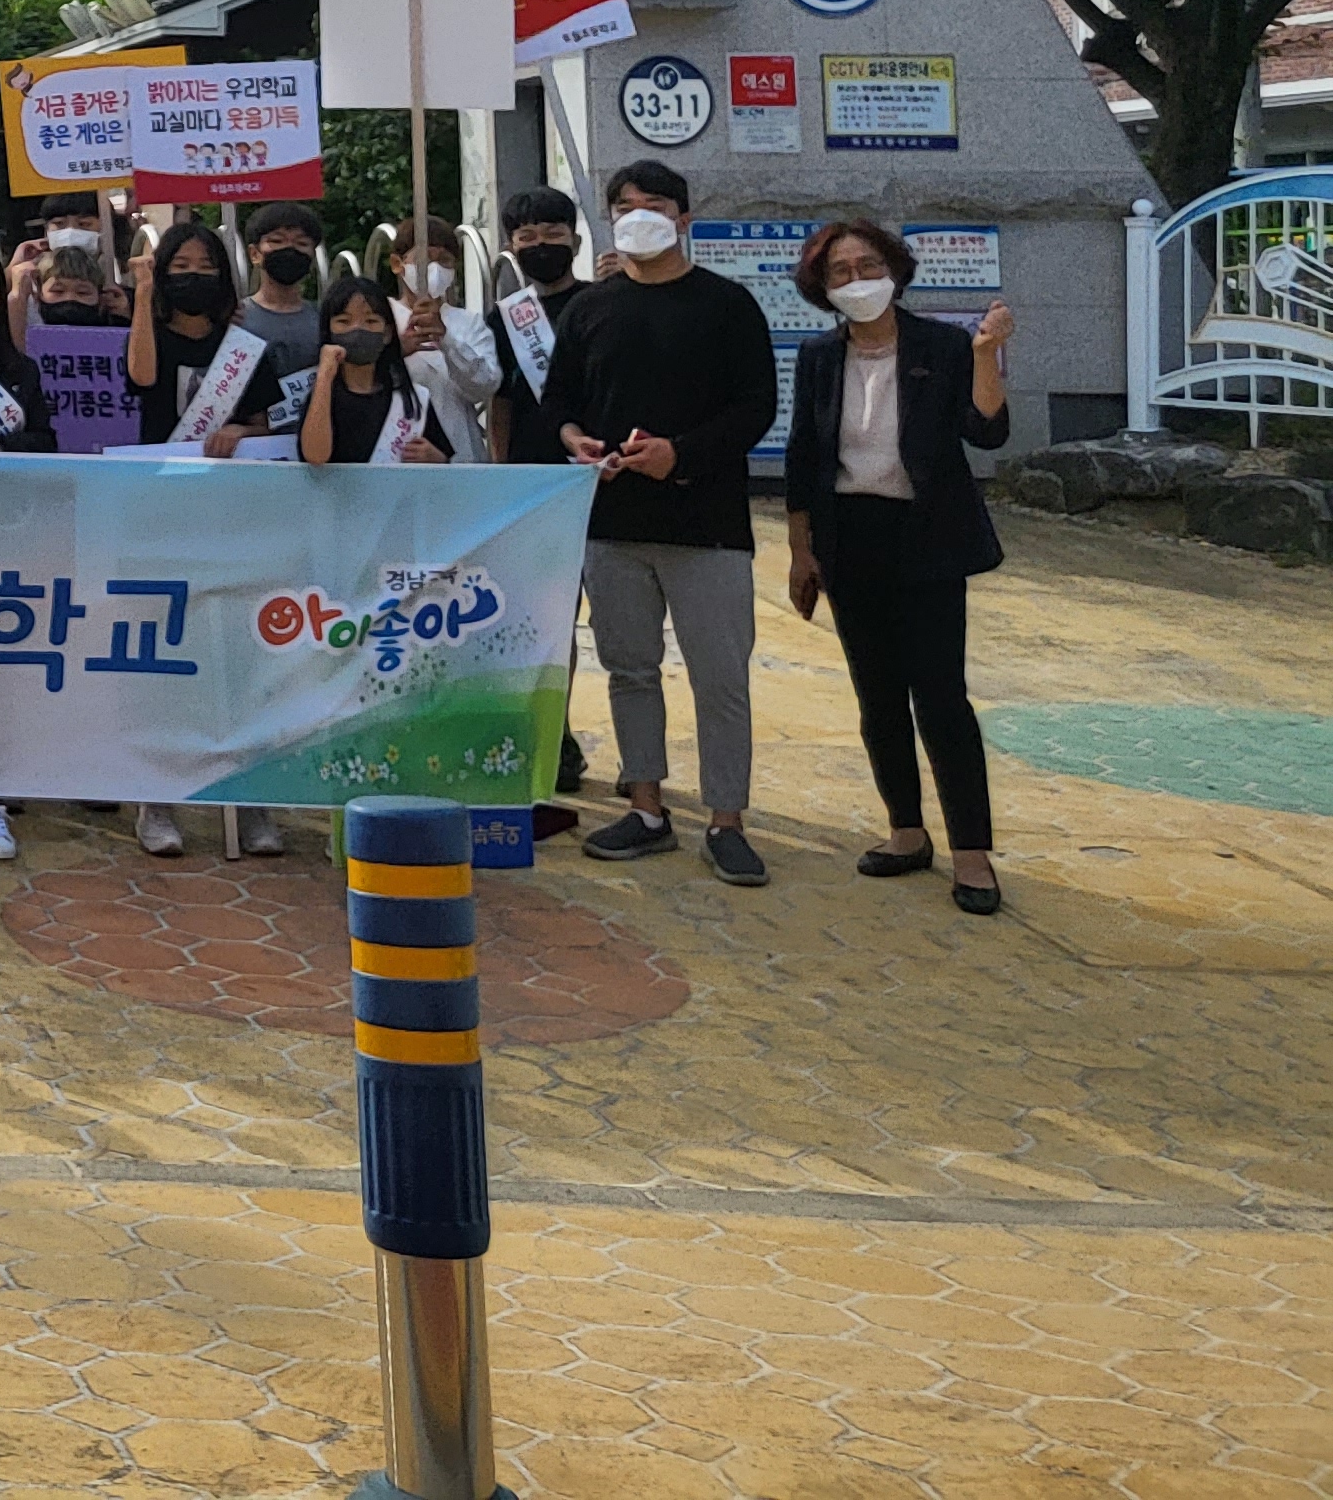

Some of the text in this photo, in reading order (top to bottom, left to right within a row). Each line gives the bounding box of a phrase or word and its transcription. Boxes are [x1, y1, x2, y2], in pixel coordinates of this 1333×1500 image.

[828, 61, 865, 78] CCTV
[35, 92, 66, 119] 지금
[71, 89, 118, 118] 즐거운
[146, 78, 219, 105] 밝아지는
[224, 76, 299, 100] 우리학교
[630, 92, 700, 119] 33-11
[38, 123, 72, 150] 좋은
[74, 120, 124, 148] 게임은
[149, 108, 222, 133] 교실마다
[40, 353, 112, 382] 학교폭력
[257, 584, 499, 672] 아이좋아
